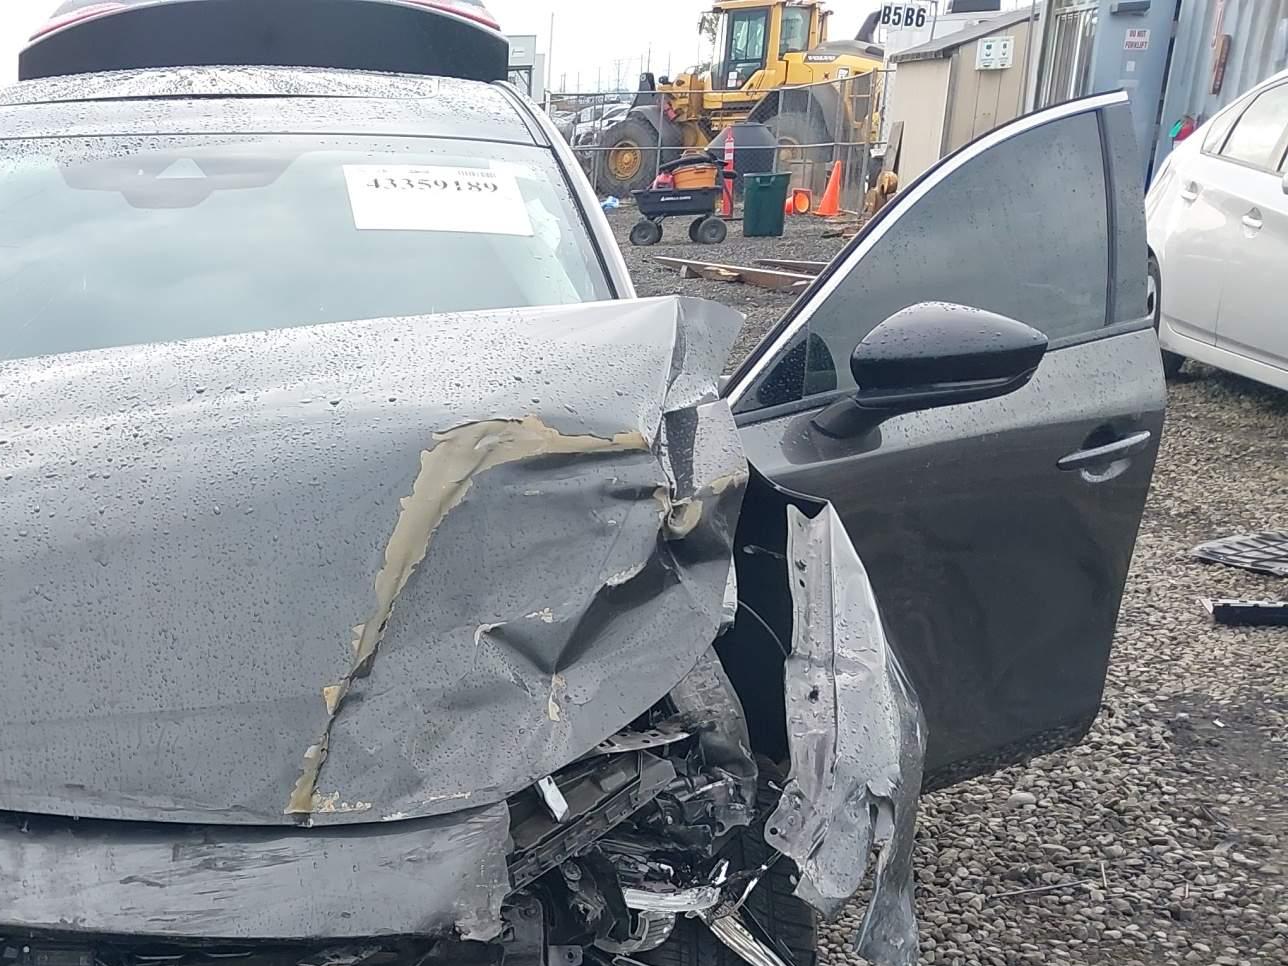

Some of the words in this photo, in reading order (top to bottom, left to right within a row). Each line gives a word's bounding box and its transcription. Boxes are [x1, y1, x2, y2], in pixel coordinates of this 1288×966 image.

[881, 5, 903, 26] B5
[904, 7, 926, 28] B6
[807, 54, 837, 62] VOLVO
[366, 177, 499, 193] 43359189
